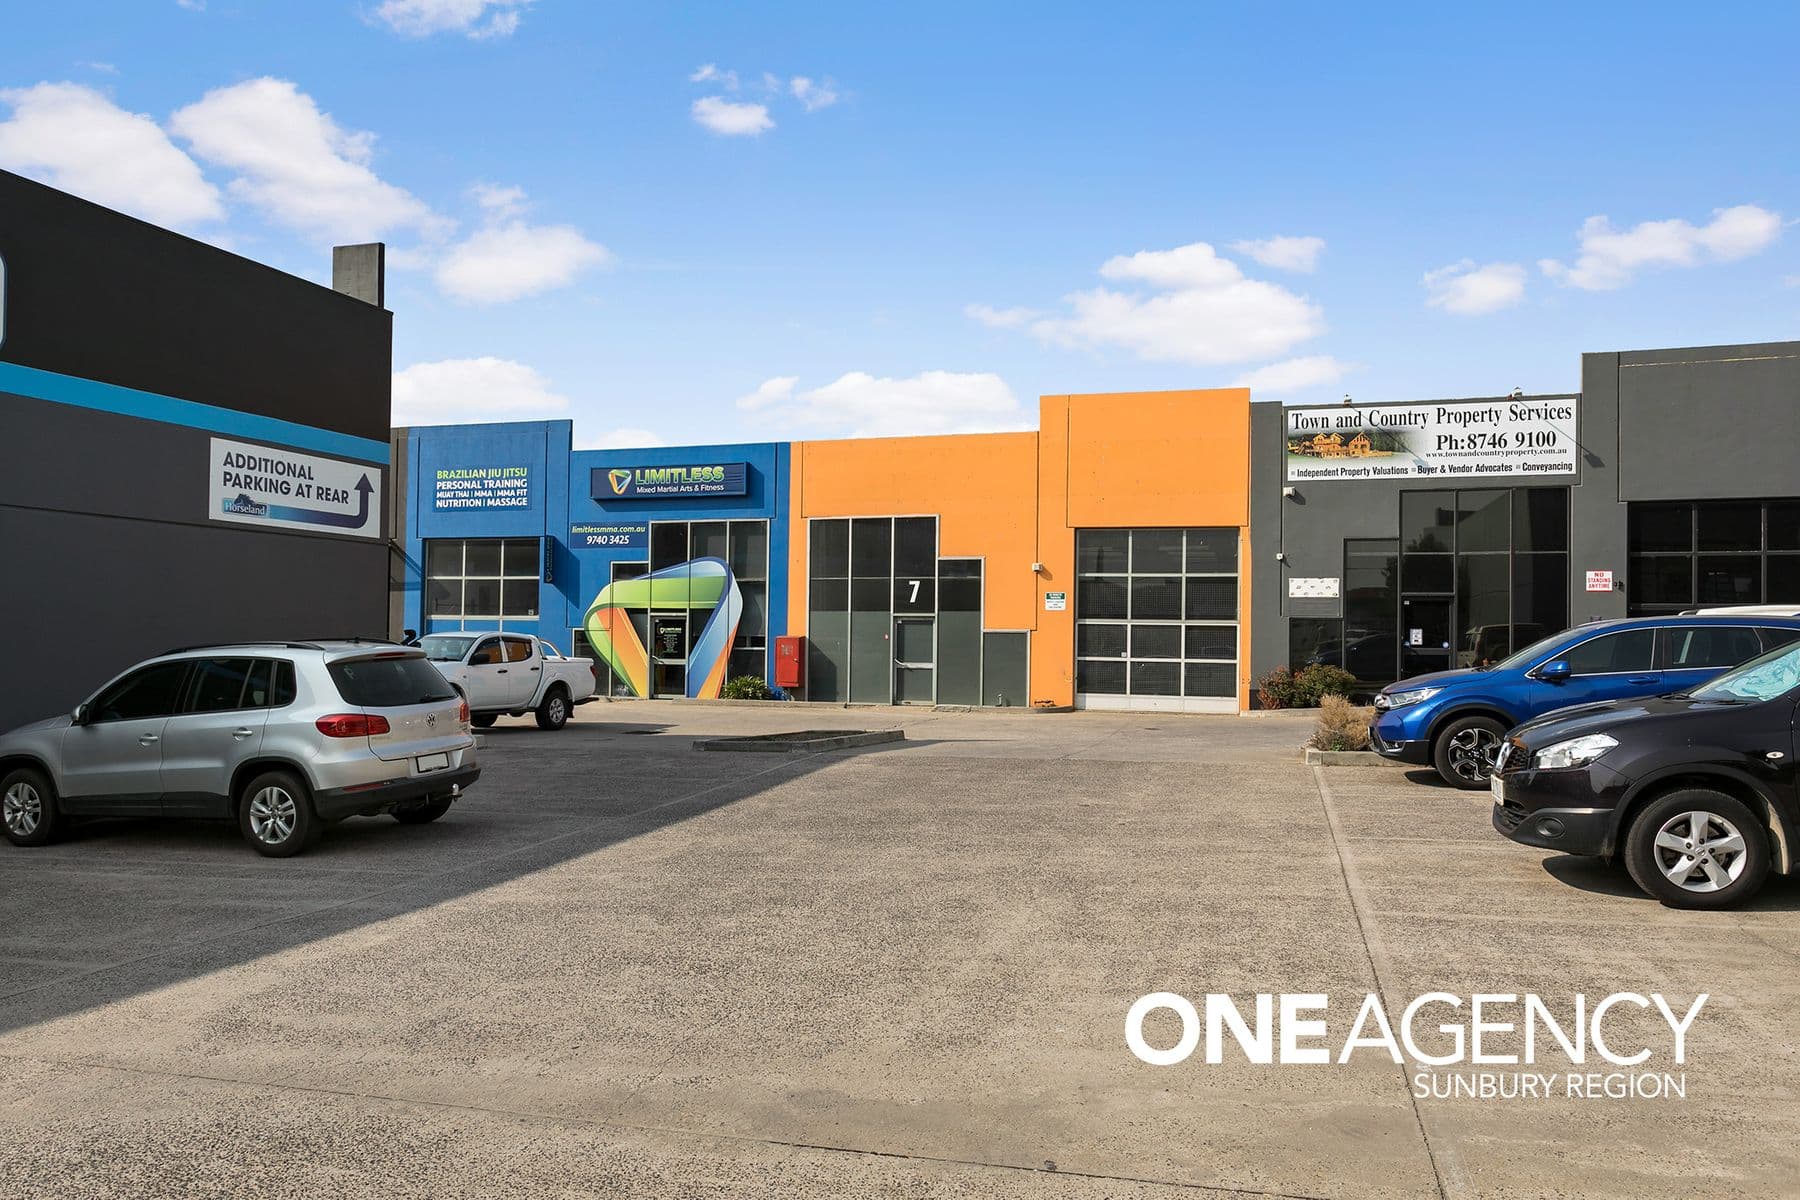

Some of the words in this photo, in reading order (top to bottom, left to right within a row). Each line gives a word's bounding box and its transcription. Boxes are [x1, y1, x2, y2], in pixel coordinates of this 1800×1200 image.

[1292, 413, 1329, 430] Town
[1336, 411, 1362, 428] and
[1369, 409, 1429, 429] Country
[1436, 407, 1502, 428] Property
[1509, 403, 1572, 421] Services
[1515, 431, 1556, 448] 9100
[1426, 448, 1567, 458] www.townandcountryproperty.com.au
[223, 451, 314, 481] ADDITIONAL
[1297, 467, 1339, 478] Independent
[1340, 466, 1370, 477] Property
[1372, 465, 1408, 475] Valuations
[1417, 465, 1438, 475] Buyer
[1448, 463, 1473, 473] Vendor
[1475, 463, 1513, 472] Advocates
[1522, 462, 1573, 472] Conveyancing
[437, 468, 486, 479] BRAZILIAN
[488, 468, 501, 479] JIU
[503, 467, 527, 478] JITSU
[635, 466, 725, 485] LIMITLESS
[223, 471, 291, 495] PARKING
[295, 483, 312, 498] AT
[317, 487, 349, 504] REAR
[437, 480, 482, 490] PERSONAL
[483, 479, 527, 489] TRAINING
[636, 485, 656, 494] Mixed
[657, 484, 678, 493] Martial
[679, 484, 693, 492] Arts
[701, 484, 724, 492] Fitness
[455, 490, 469, 498] THAI
[497, 489, 515, 497] MMA
[225, 502, 266, 515] Horseland
[436, 499, 481, 508] NUTRITION
[487, 498, 527, 506] MASSAGE
[572, 525, 646, 534] limitlessmma.com.au
[587, 535, 607, 545] 9740
[609, 535, 629, 544] 3425
[909, 581, 920, 602] 7
